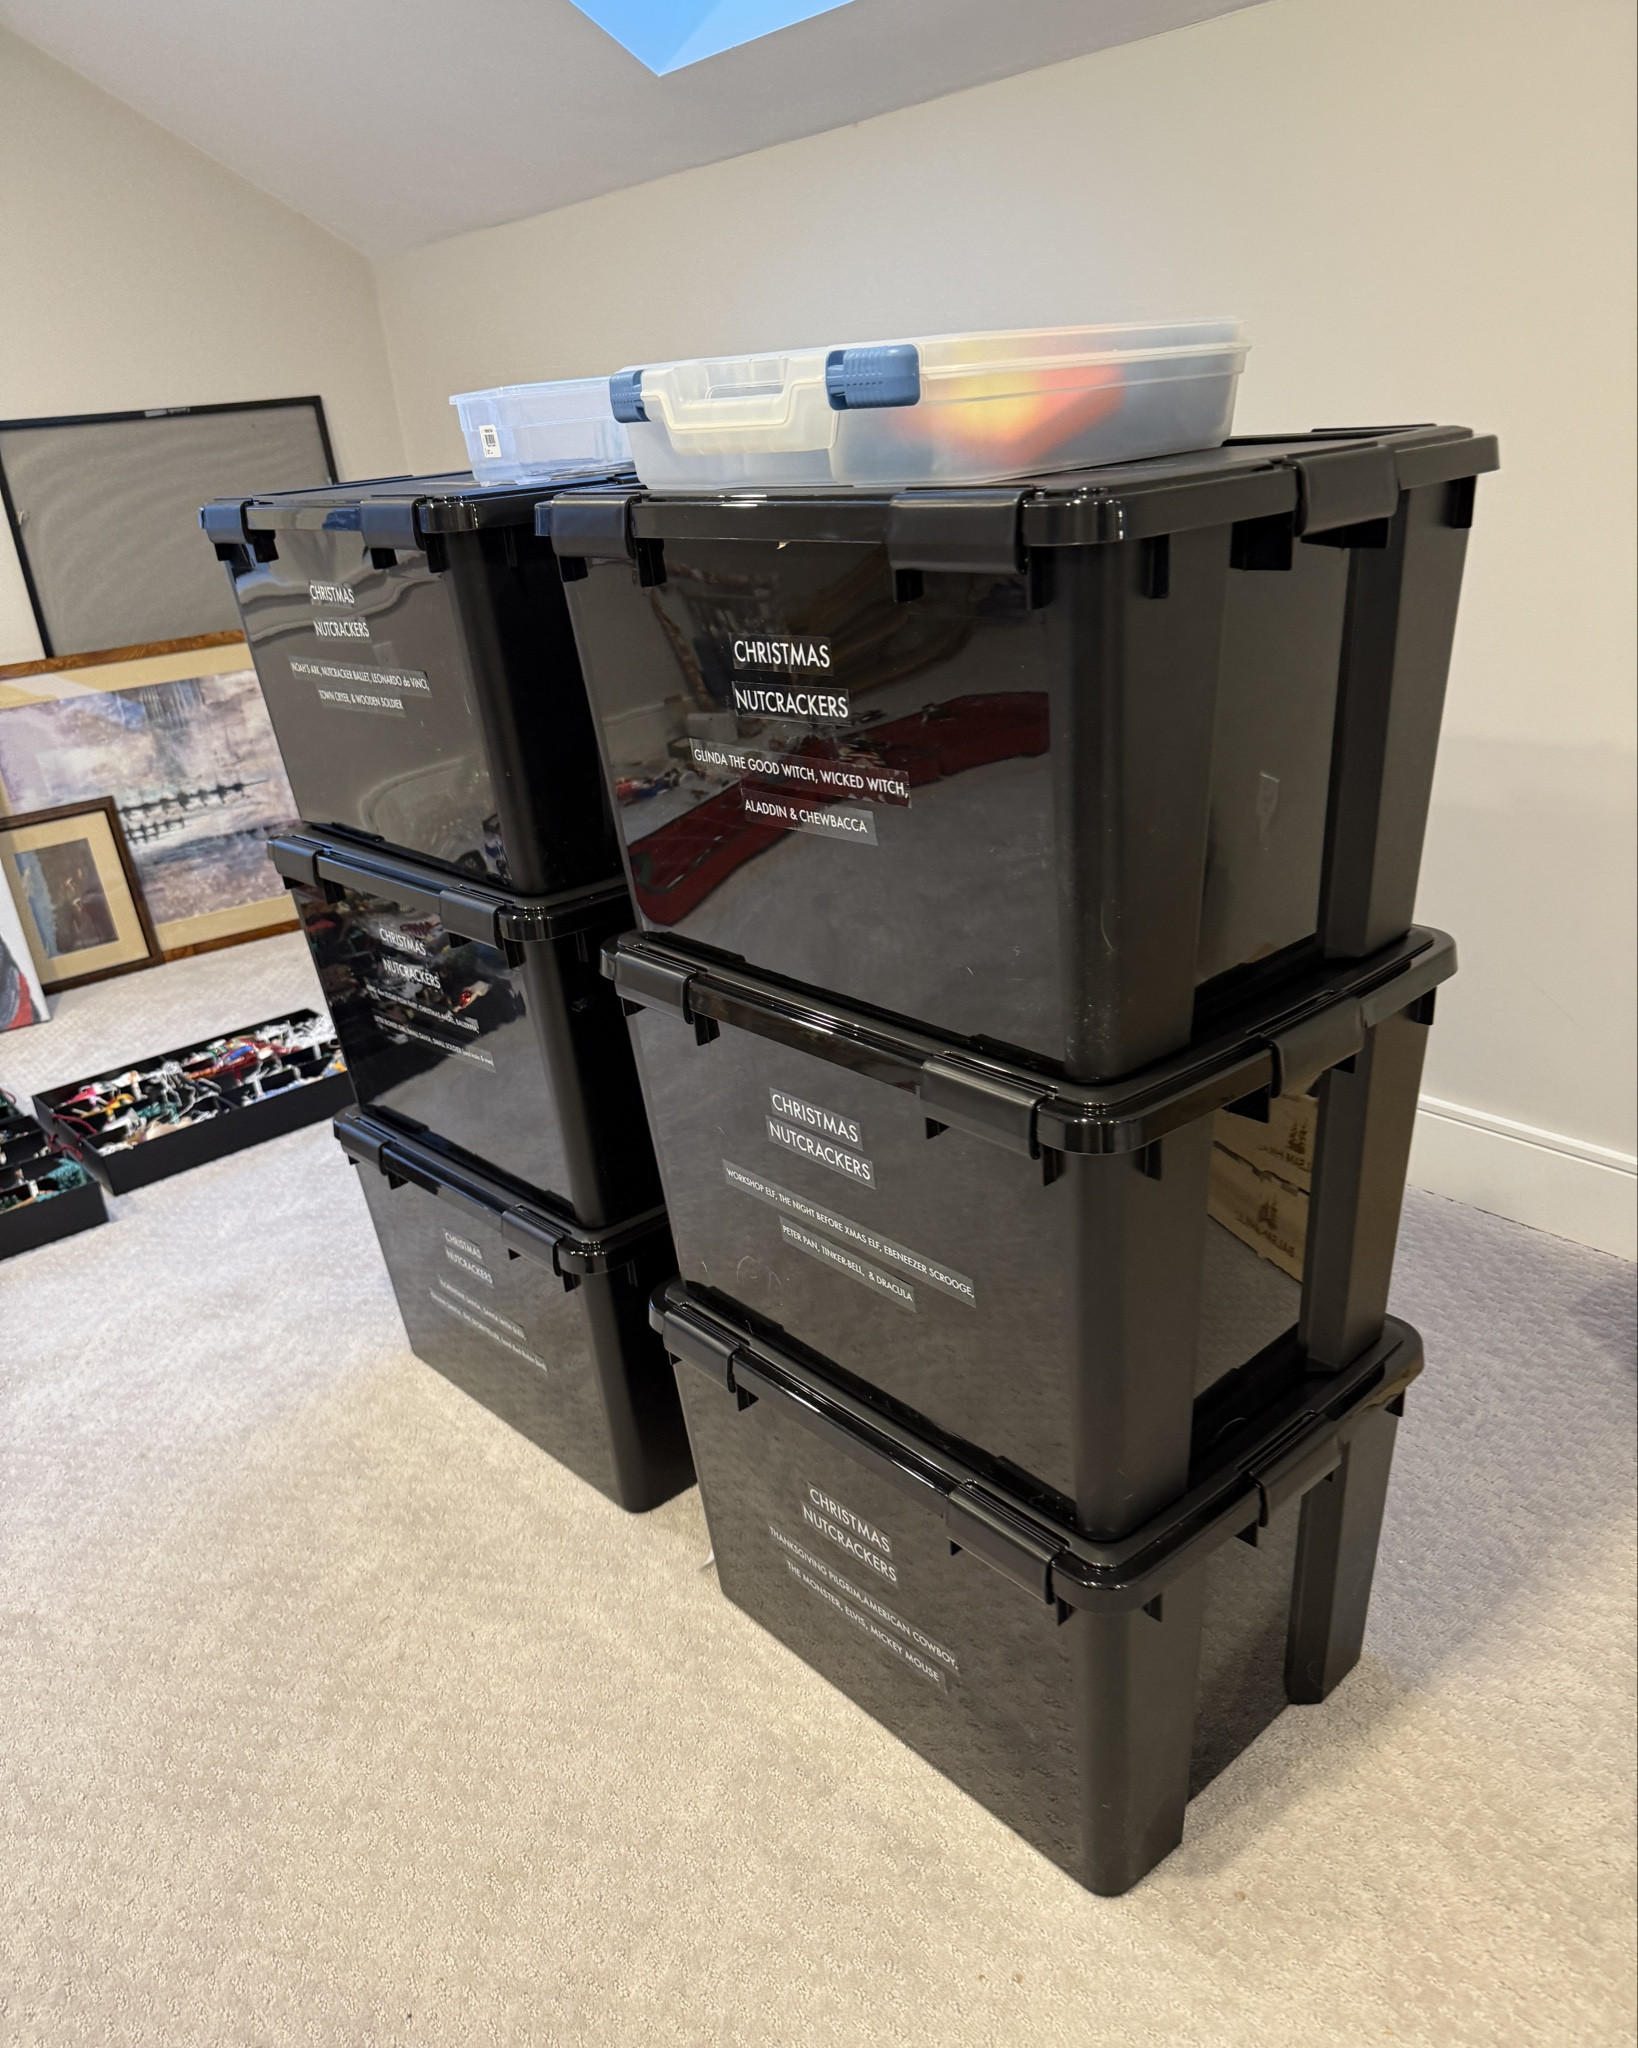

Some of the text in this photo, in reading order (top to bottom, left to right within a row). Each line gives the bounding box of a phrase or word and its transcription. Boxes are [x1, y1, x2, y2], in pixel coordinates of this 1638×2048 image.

[310, 584, 355, 604] CHRISTMAS
[313, 620, 370, 638] NUTCRACKERS
[733, 640, 831, 668] CHRISTMAS
[321, 666, 354, 681] NUTCRACKER
[371, 672, 402, 686] LEONARDO
[318, 689, 335, 701] TOWN
[355, 694, 381, 707] WOODEN
[734, 688, 849, 718] NUTCRACKERS
[694, 749, 909, 799] GLINDA THE GOOD WITCH, WICKED WITCH,
[745, 799, 868, 834] ALADDIN & CHEWBACCA
[380, 928, 427, 956] CHRISTMAS
[382, 957, 441, 989] NUTCRACKERS
[771, 1093, 859, 1143] CHRISTMAS
[769, 1121, 871, 1180] NUTCRACKERS
[445, 1232, 482, 1260] CHRISTMAS
[726, 1167, 974, 1298] WORKSHOP ELF, THE NIGHT BEFORE XMAS ELF, EBENEEZER SCROOGE,
[446, 1247, 493, 1284] NUTCRACKERS
[782, 1224, 801, 1242] PETER
[802, 1236, 821, 1252] PAN,
[868, 1271, 876, 1281] &
[876, 1275, 914, 1303] DRACULA
[809, 1488, 891, 1554] CHRISTMAS
[769, 1525, 827, 1575] THANKSGIVING
[803, 1505, 898, 1582] NUTCRACKERS
[787, 1560, 801, 1578] THE
[870, 1625, 902, 1654] MICKEY
[905, 1651, 940, 1682] MOUSE
